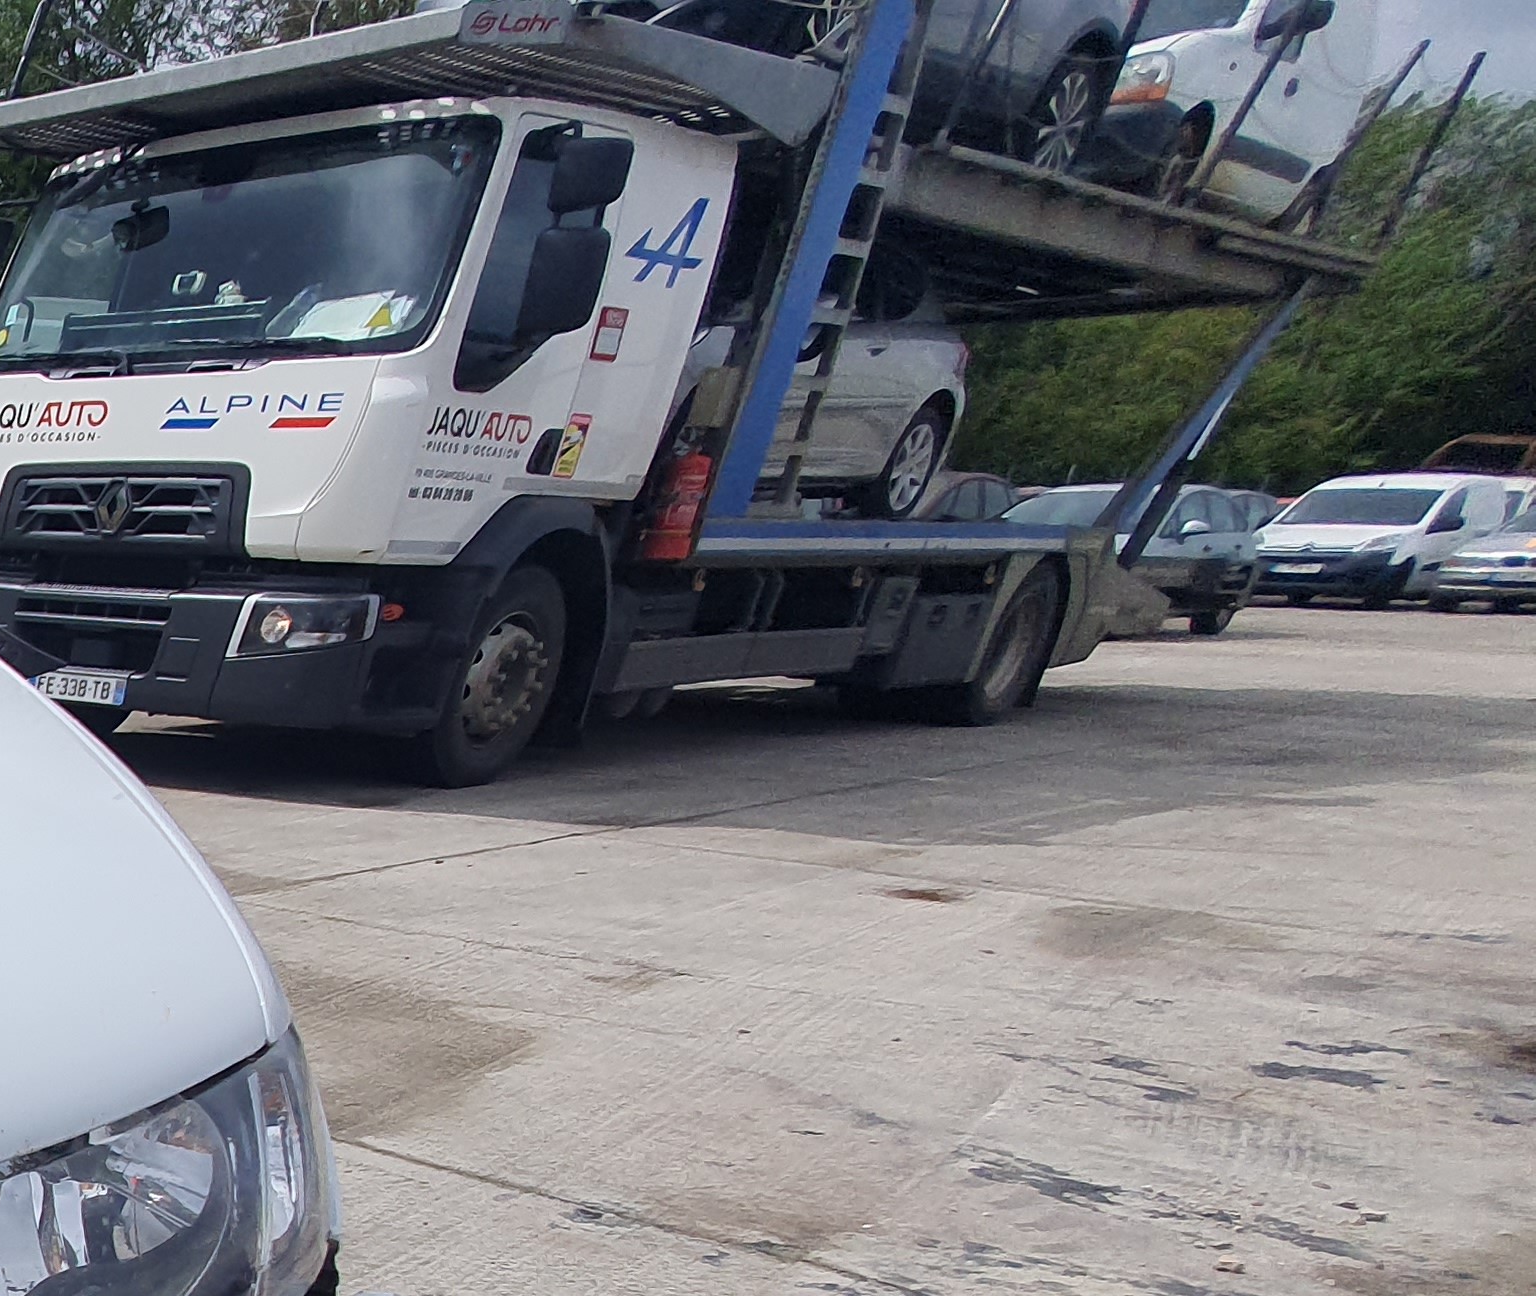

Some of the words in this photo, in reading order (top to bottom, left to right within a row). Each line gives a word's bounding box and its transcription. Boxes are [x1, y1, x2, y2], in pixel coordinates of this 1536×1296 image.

[165, 392, 345, 415] ALPINE
[426, 406, 533, 444] JAQU'AUTO
[37, 675, 112, 700] FE-338-TB
